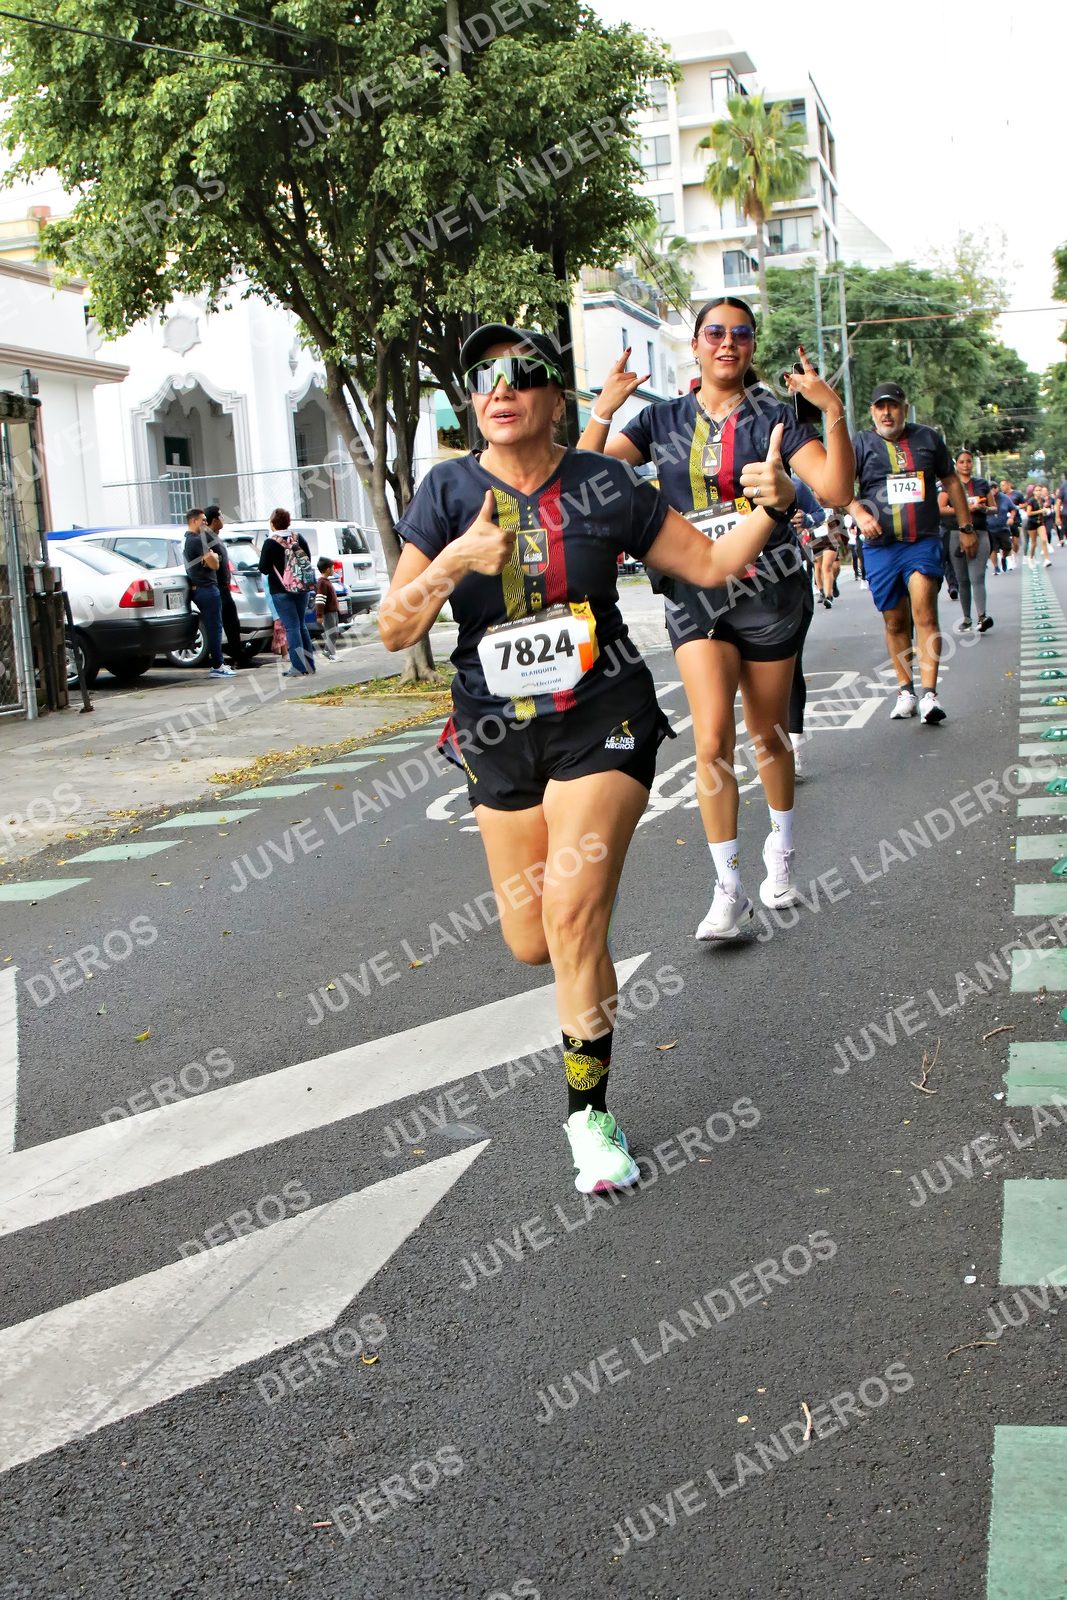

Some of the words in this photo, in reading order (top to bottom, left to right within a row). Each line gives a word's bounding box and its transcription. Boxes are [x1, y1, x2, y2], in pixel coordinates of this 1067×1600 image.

[893, 482, 917, 493] 1742
[494, 628, 576, 671] 7824
[520, 665, 558, 678] BLANQUITA
[604, 742, 635, 750] NEGROS
